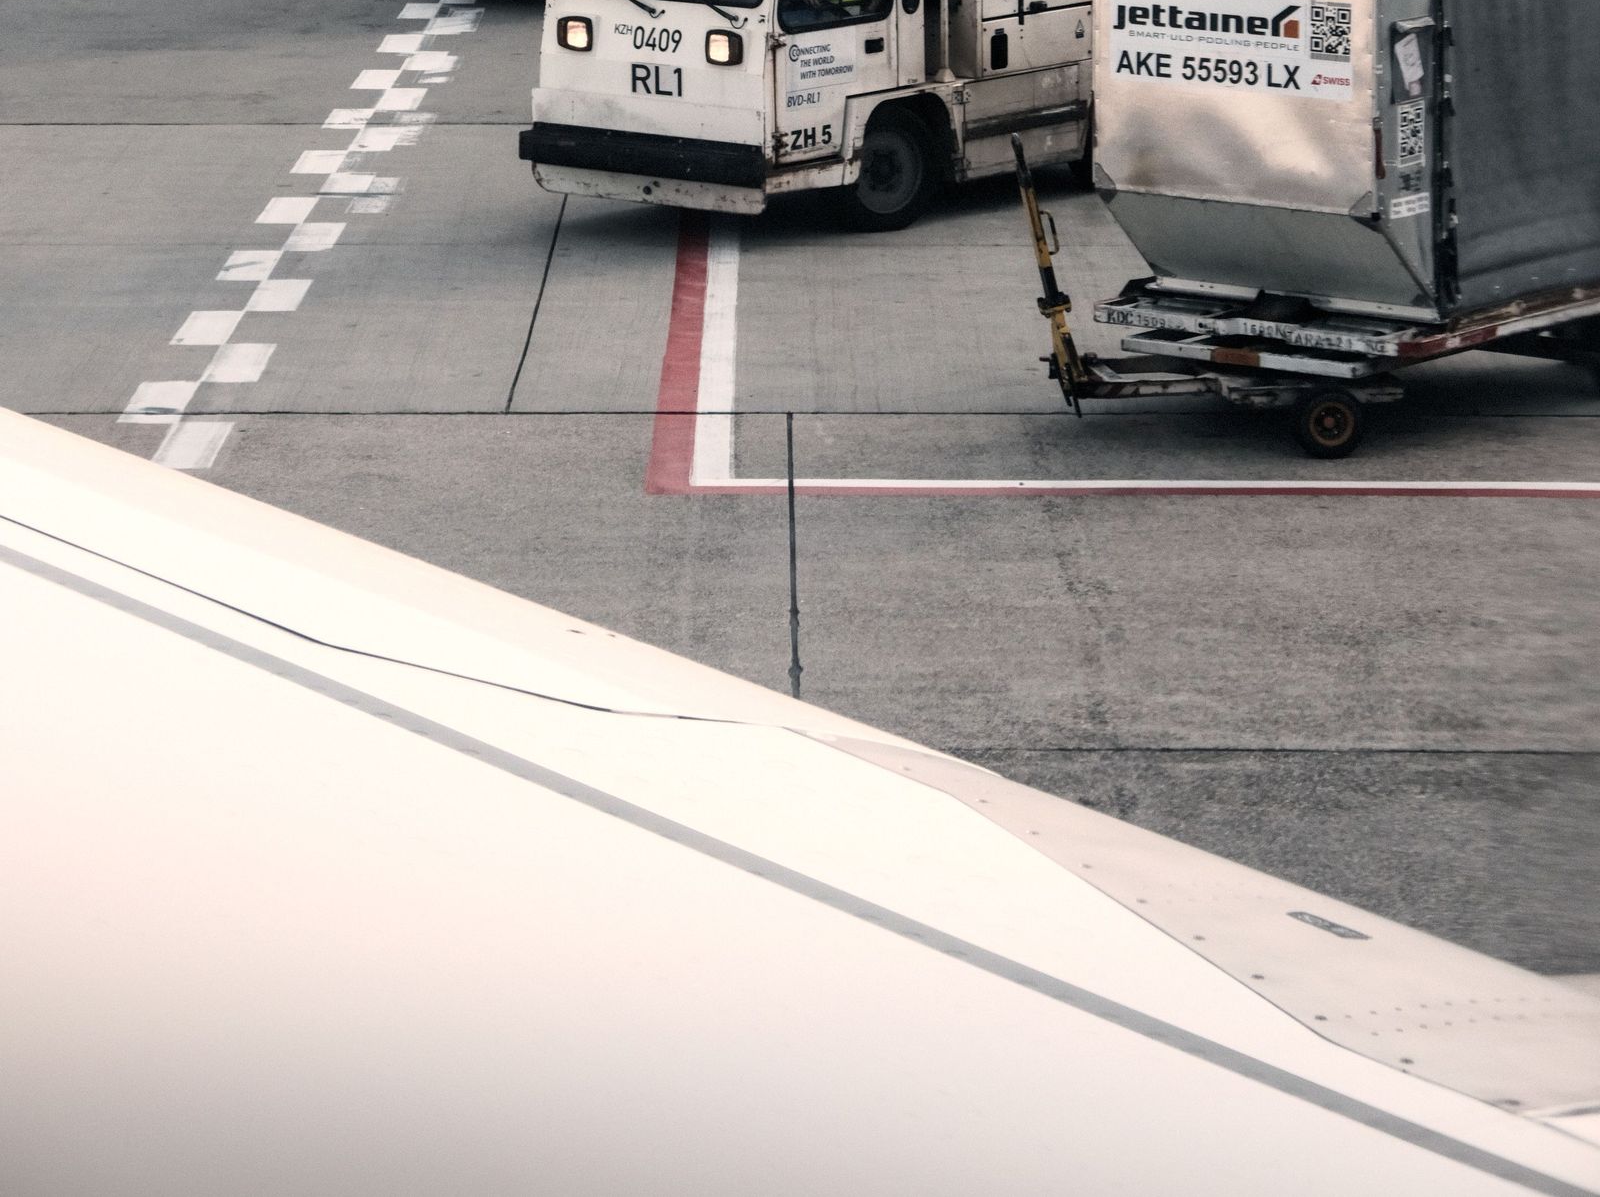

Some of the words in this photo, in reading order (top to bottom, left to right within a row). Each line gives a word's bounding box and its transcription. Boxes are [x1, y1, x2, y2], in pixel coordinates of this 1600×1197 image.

[1113, 4, 1301, 38] jettainer
[614, 24, 633, 35] KZH
[633, 25, 682, 53] 0409
[800, 59, 811, 68] THE
[813, 55, 835, 66] WORLD
[800, 70, 816, 80] WITH
[818, 65, 854, 77] TOMORROW
[1116, 50, 1172, 78] AKE
[1182, 56, 1259, 86] 55593
[1267, 63, 1301, 90] LX
[631, 63, 682, 97] RL1
[1323, 76, 1350, 86] SWISS
[787, 92, 820, 107] BVD-RL1
[790, 127, 816, 151] ZH
[821, 124, 832, 144] 5
